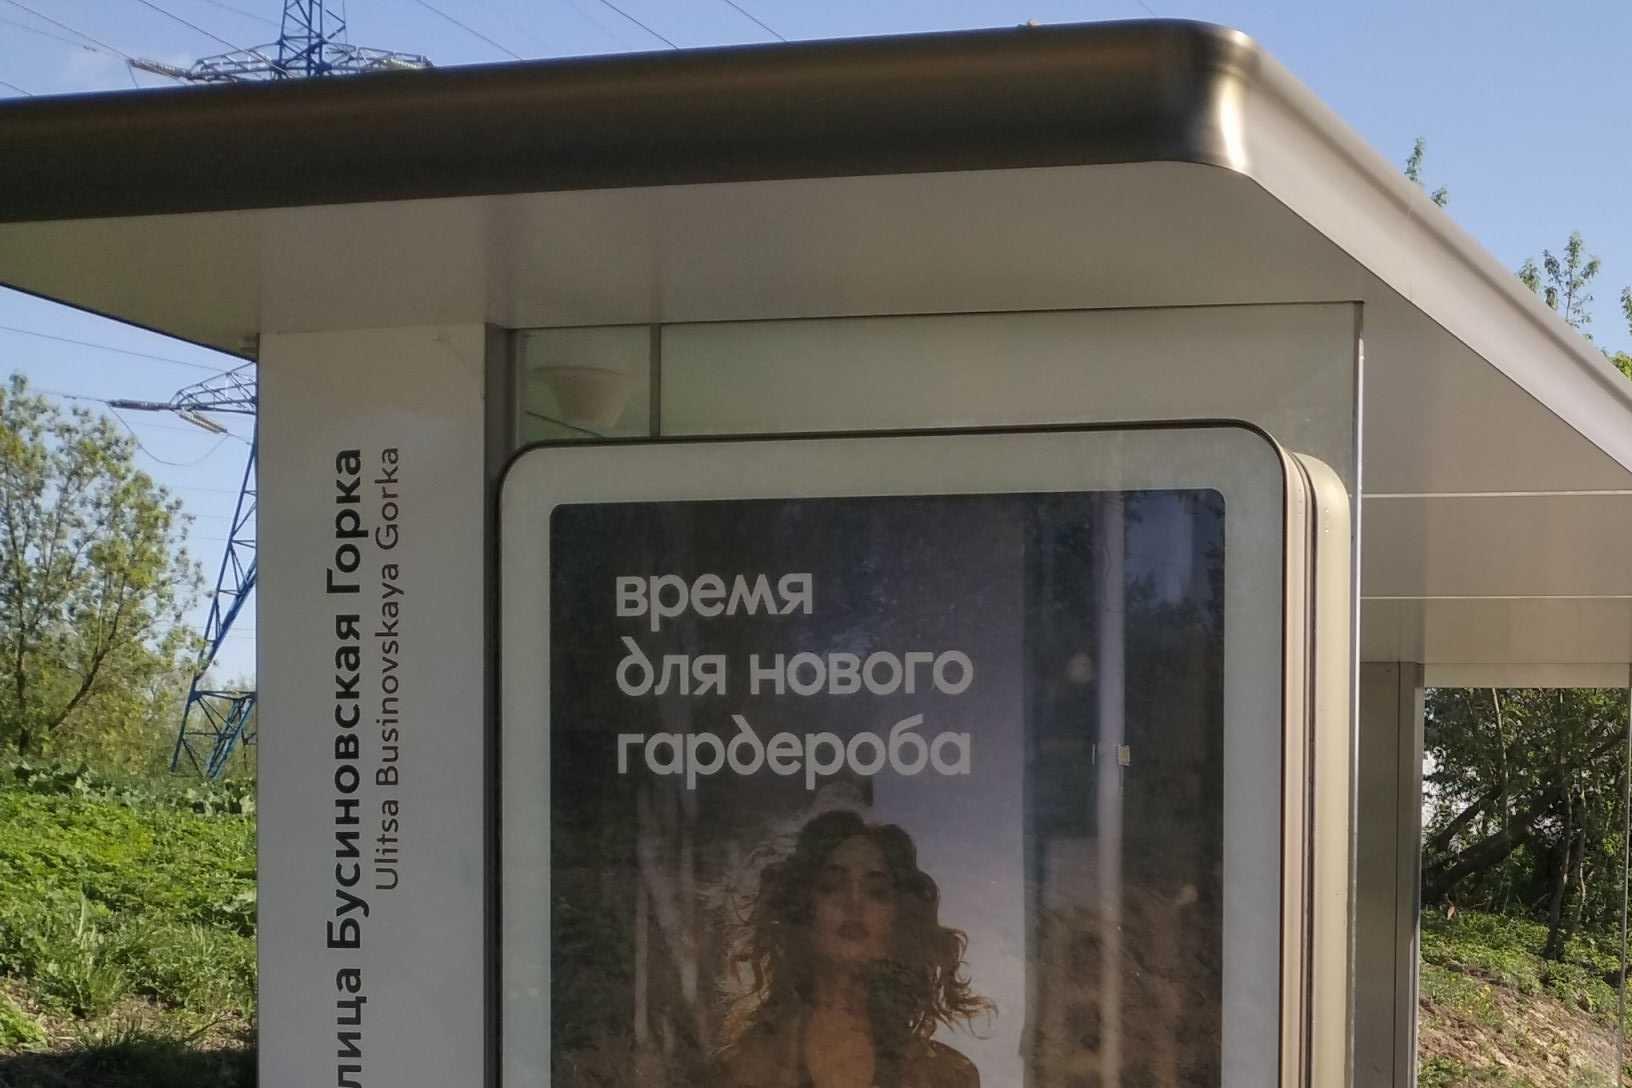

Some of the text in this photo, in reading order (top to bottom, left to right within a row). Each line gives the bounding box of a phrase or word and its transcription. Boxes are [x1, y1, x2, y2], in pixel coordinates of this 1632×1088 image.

[326, 449, 369, 593] Горка
[615, 572, 814, 633] время
[374, 446, 405, 891] Ulitsa Businovskaya Gorka
[615, 635, 974, 697] для нового
[326, 614, 370, 949] Бусиновская
[616, 713, 972, 791] гардероба
